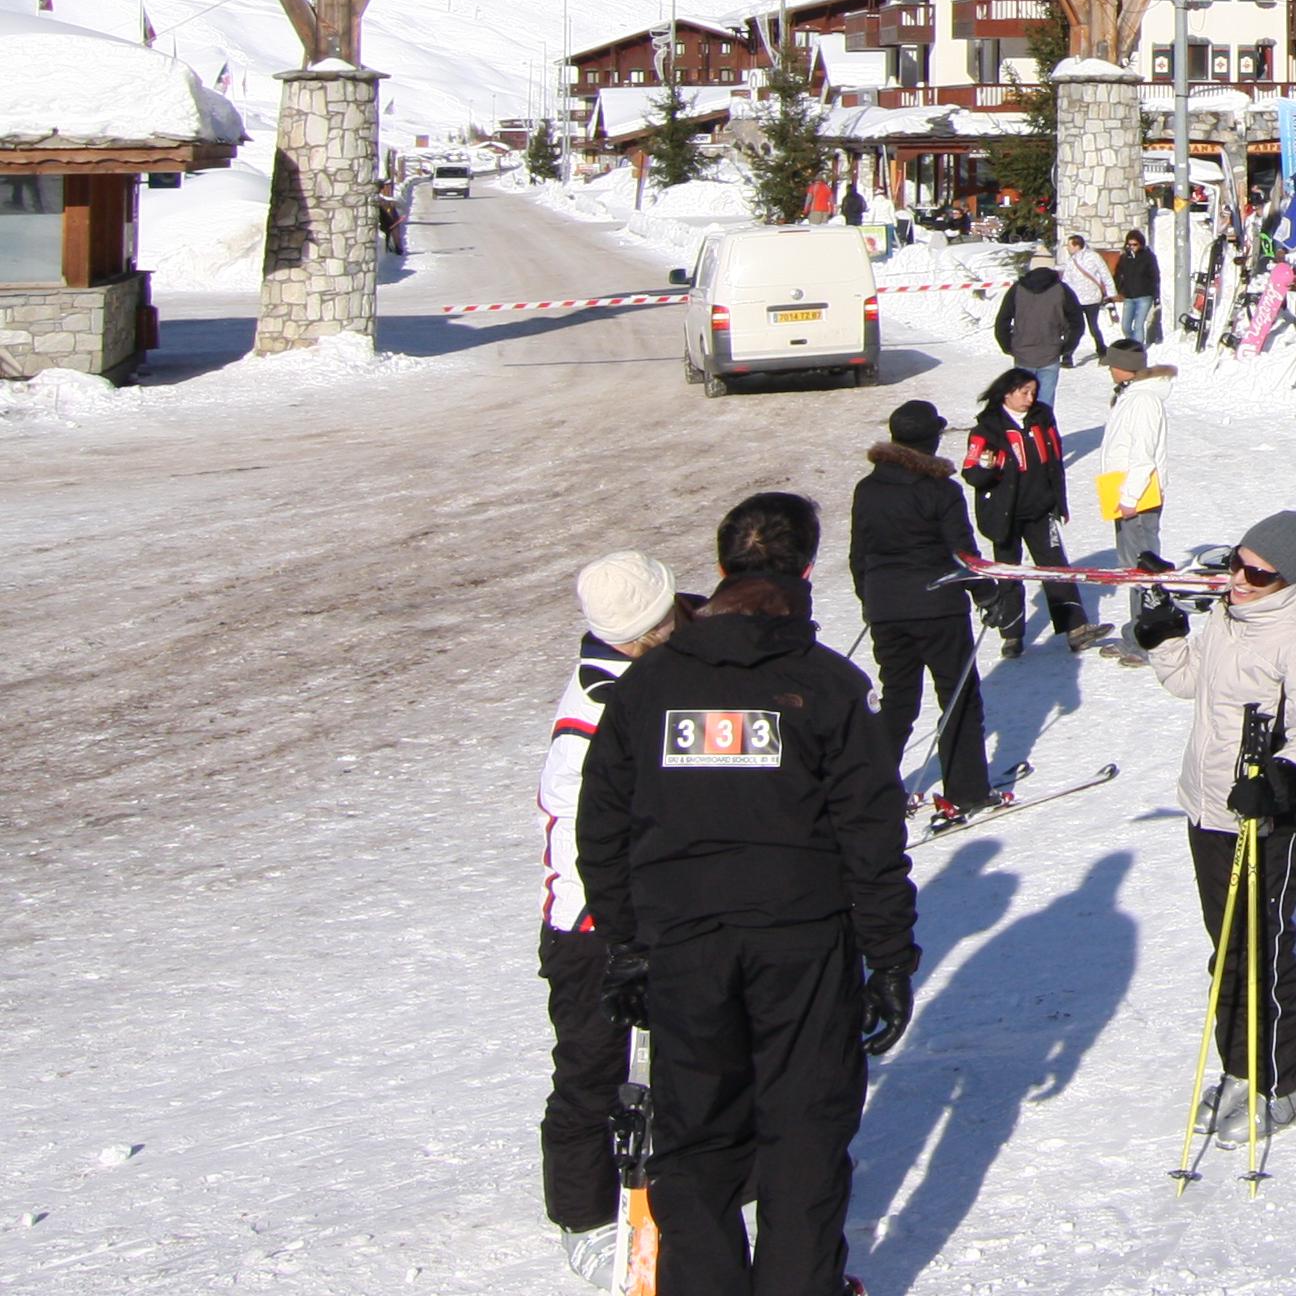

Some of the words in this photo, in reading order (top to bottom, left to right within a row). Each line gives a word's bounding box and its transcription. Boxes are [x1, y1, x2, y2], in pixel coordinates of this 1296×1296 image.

[677, 719, 695, 748] 3
[715, 719, 734, 748] 3
[751, 719, 770, 748] 3
